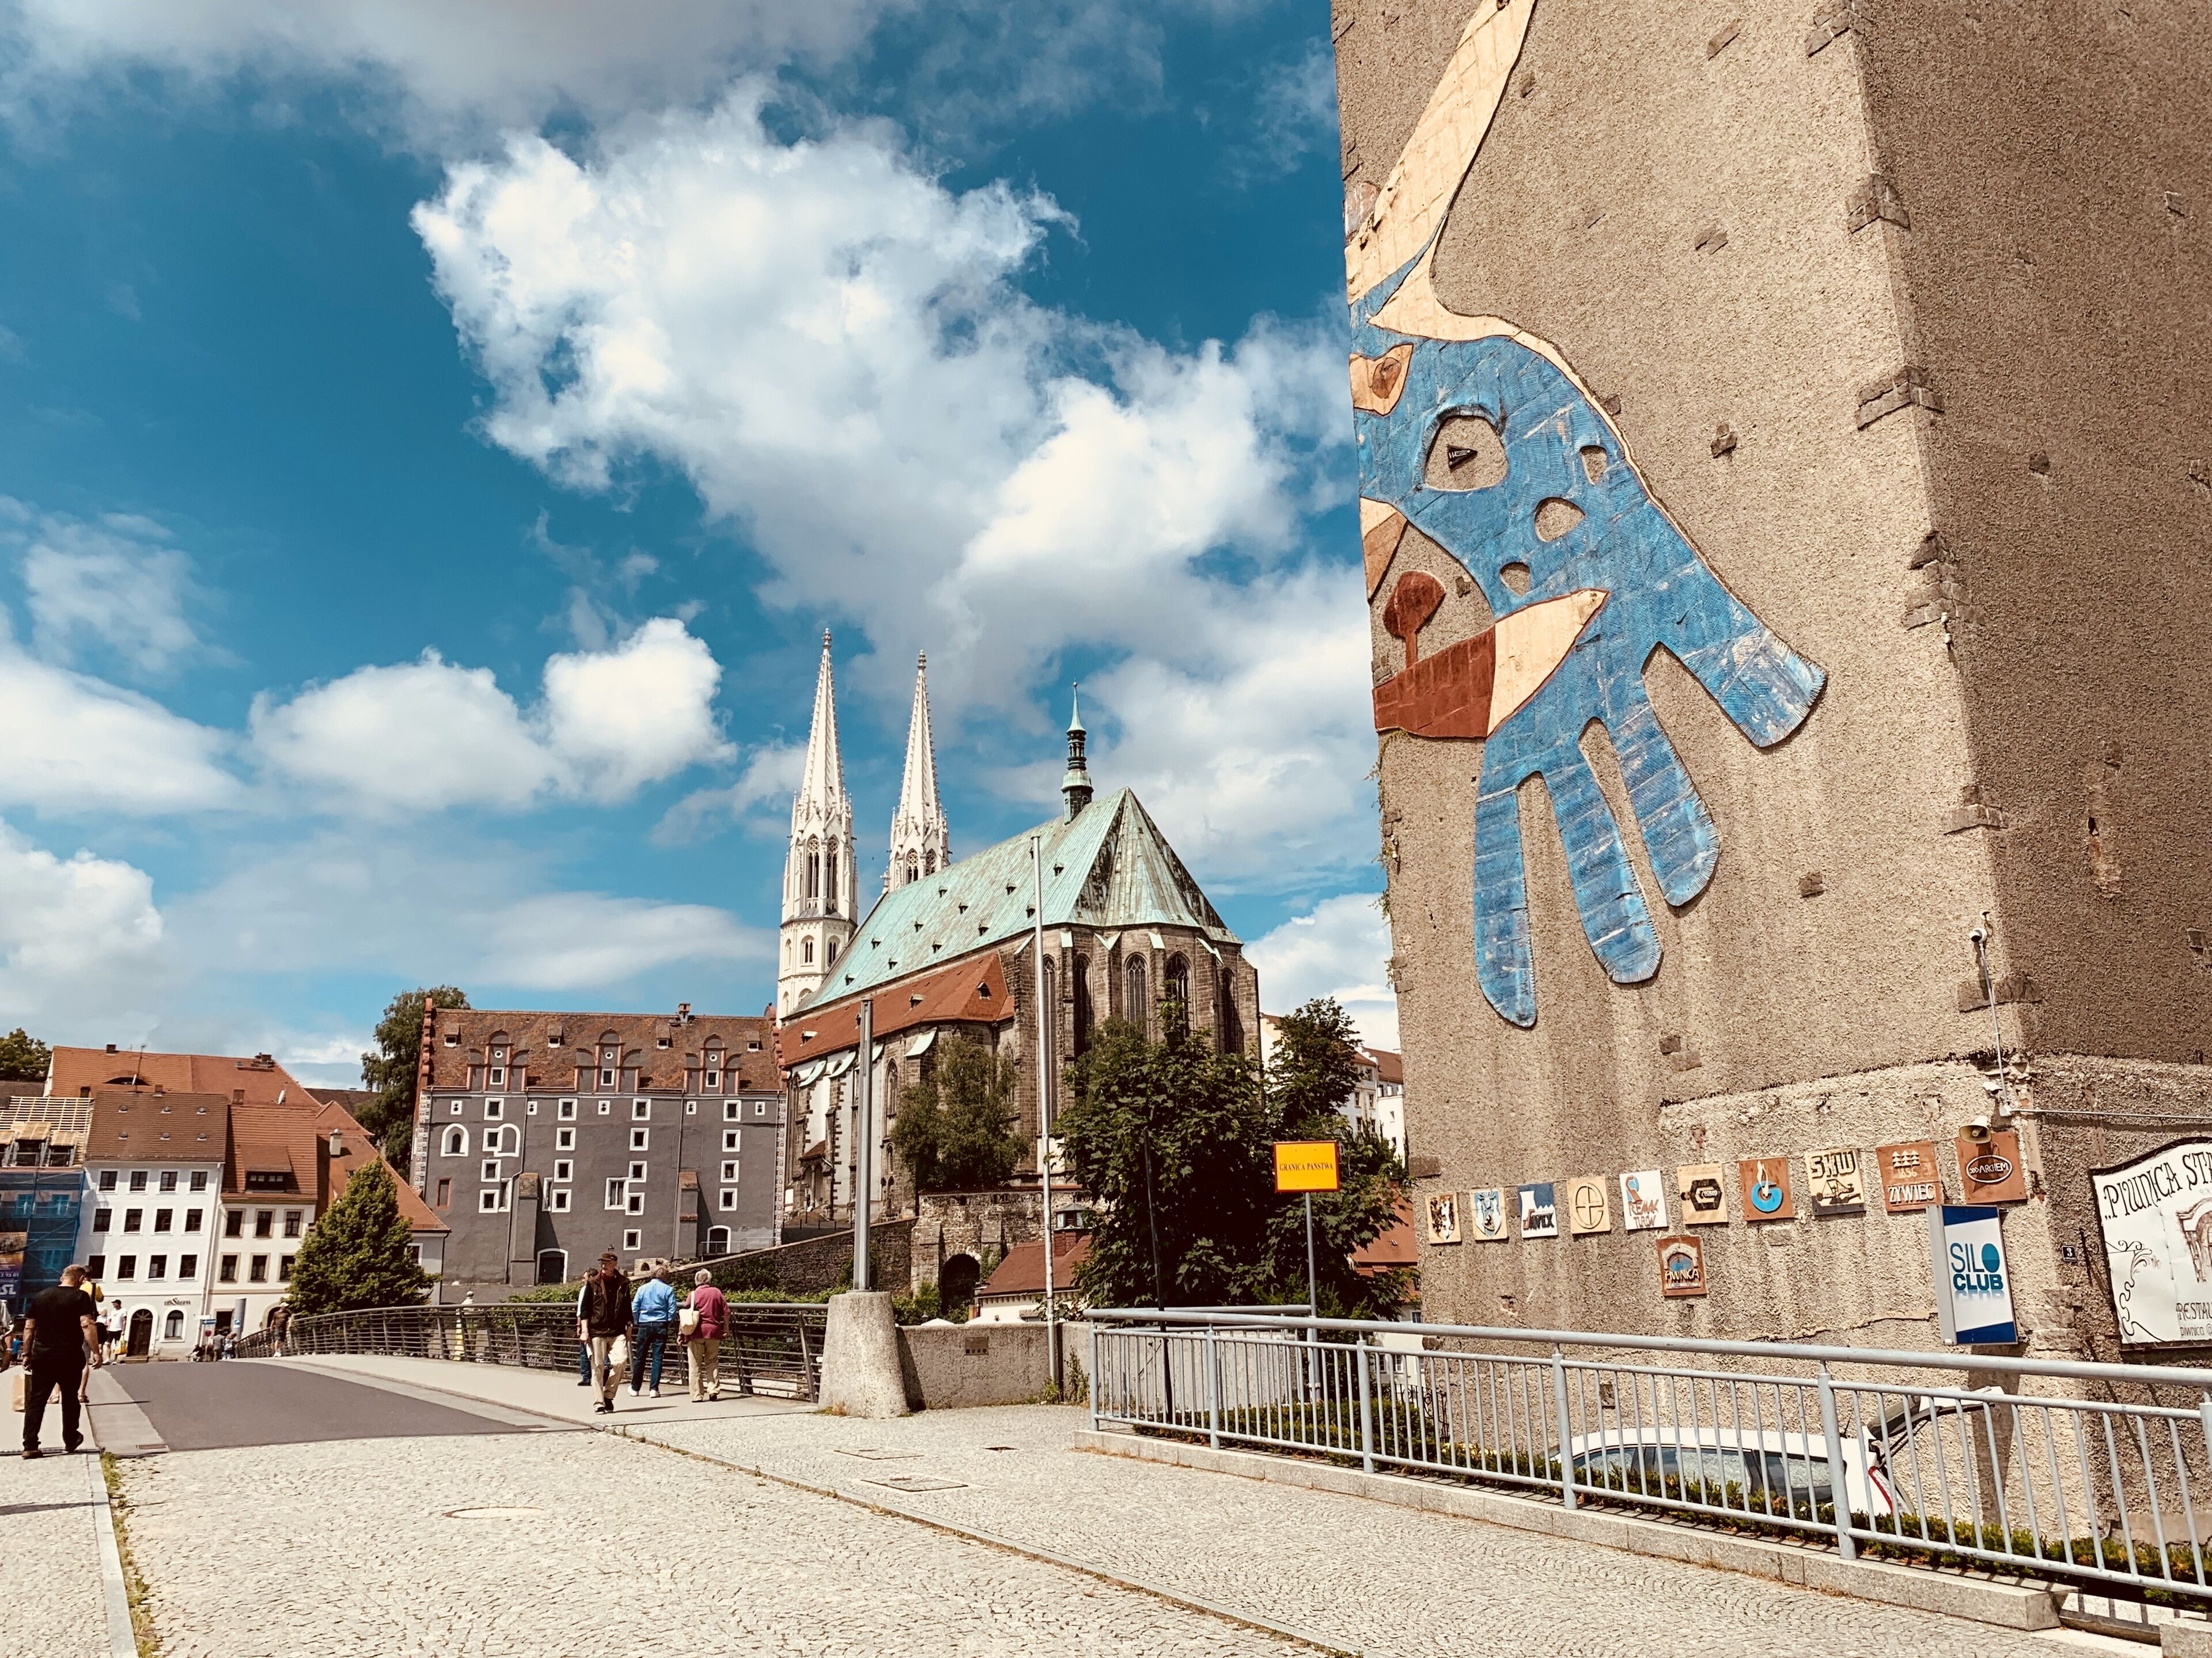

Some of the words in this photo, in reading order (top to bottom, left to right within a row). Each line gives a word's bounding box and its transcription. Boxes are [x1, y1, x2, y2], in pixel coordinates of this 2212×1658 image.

[1979, 1162, 2009, 1173] ARCHEM
[1950, 1242, 2000, 1273] SILO
[2066, 1247, 2073, 1257] 3
[1953, 1273, 2003, 1291] CLUB
